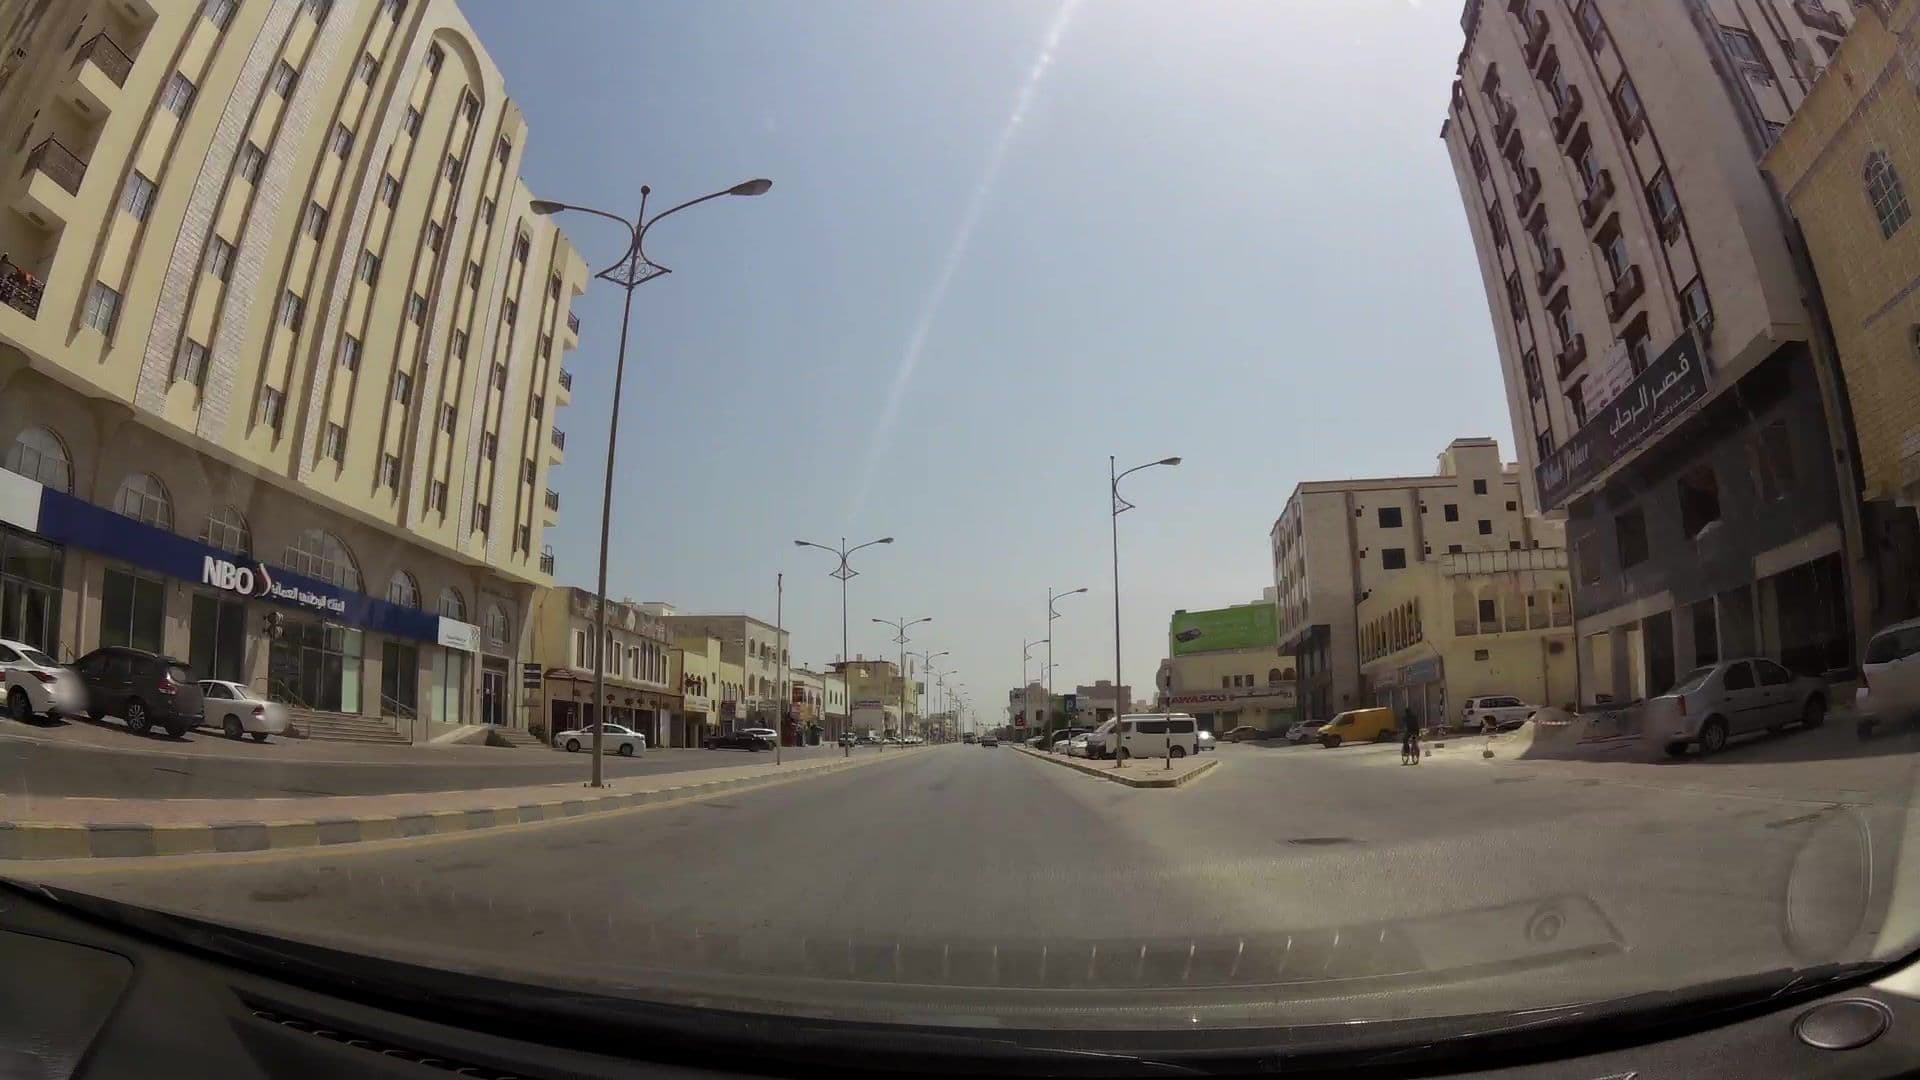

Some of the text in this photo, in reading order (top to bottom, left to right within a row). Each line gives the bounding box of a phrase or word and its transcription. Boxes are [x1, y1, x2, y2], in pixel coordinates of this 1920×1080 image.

[1652, 352, 1690, 415] قصر
[1609, 384, 1649, 439] الرحاب
[202, 555, 254, 595] NBO
